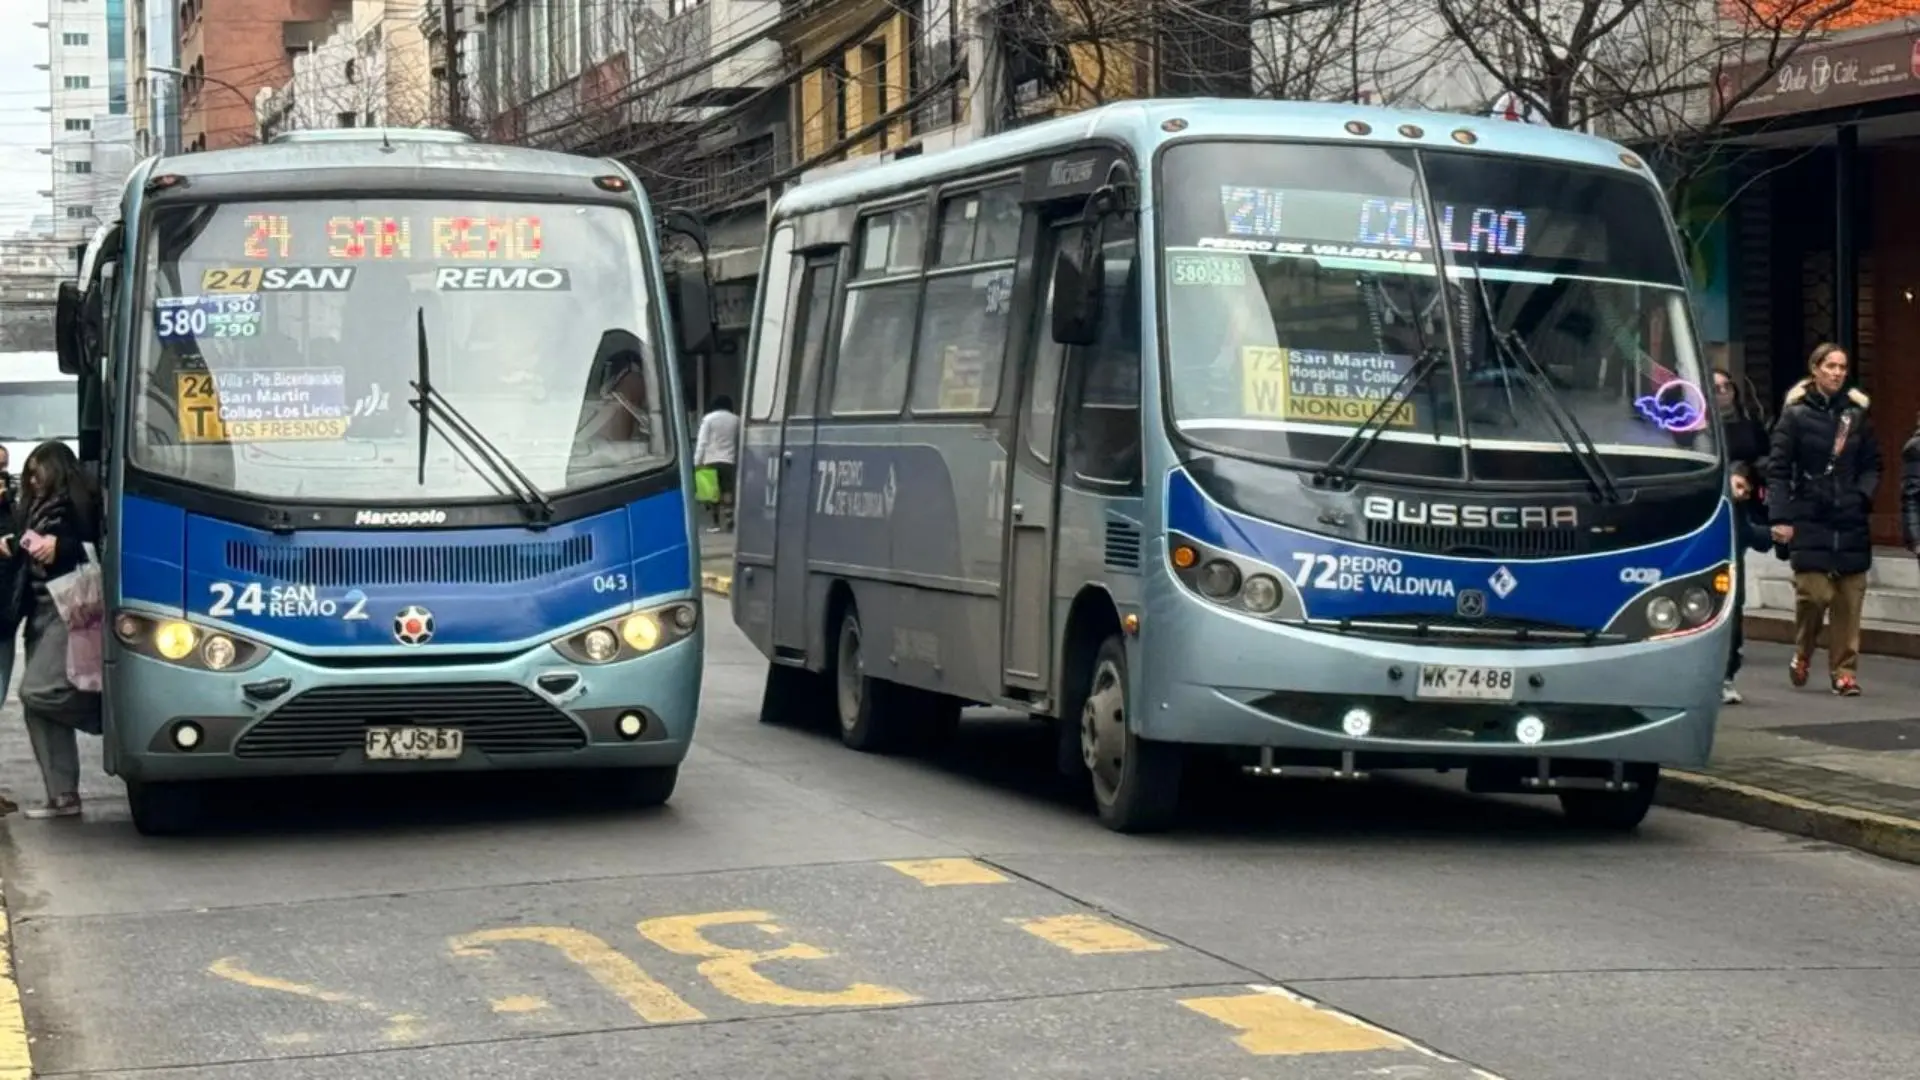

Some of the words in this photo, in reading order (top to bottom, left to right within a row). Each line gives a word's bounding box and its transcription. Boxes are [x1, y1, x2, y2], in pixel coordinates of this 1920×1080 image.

[243, 212, 291, 258] 24
[325, 214, 411, 260] SAN
[433, 216, 544, 260] REMO
[1359, 199, 1526, 255] COLLAO
[1198, 237, 1273, 252] PEDRO
[1275, 242, 1307, 253] DE
[1311, 244, 1423, 261] VALDIVIA
[206, 270, 253, 290] 24
[262, 268, 352, 289] SAN
[436, 268, 563, 289] REMO
[1175, 264, 1207, 282] 580
[217, 300, 255, 313] 190
[159, 309, 207, 336] 580
[214, 323, 256, 337] 290
[1250, 351, 1282, 372] 72
[1290, 351, 1327, 365] San
[1290, 363, 1348, 380] Hospital
[183, 376, 215, 397] 24
[219, 390, 252, 404] San
[1252, 379, 1278, 412] W
[188, 406, 213, 437] T
[274, 405, 300, 418] Los
[222, 422, 256, 437] LOS
[260, 420, 338, 437] FRESNOS
[816, 460, 836, 515] 72
[355, 510, 447, 525] Marcopolo
[1292, 552, 1338, 590] 72
[1340, 554, 1403, 576] PEDRO
[270, 585, 316, 601] SAN
[593, 574, 628, 593] 043
[1339, 573, 1365, 592] DE
[1369, 575, 1455, 597] VALDIVIA
[208, 582, 266, 617] 24
[269, 600, 337, 617] REMO
